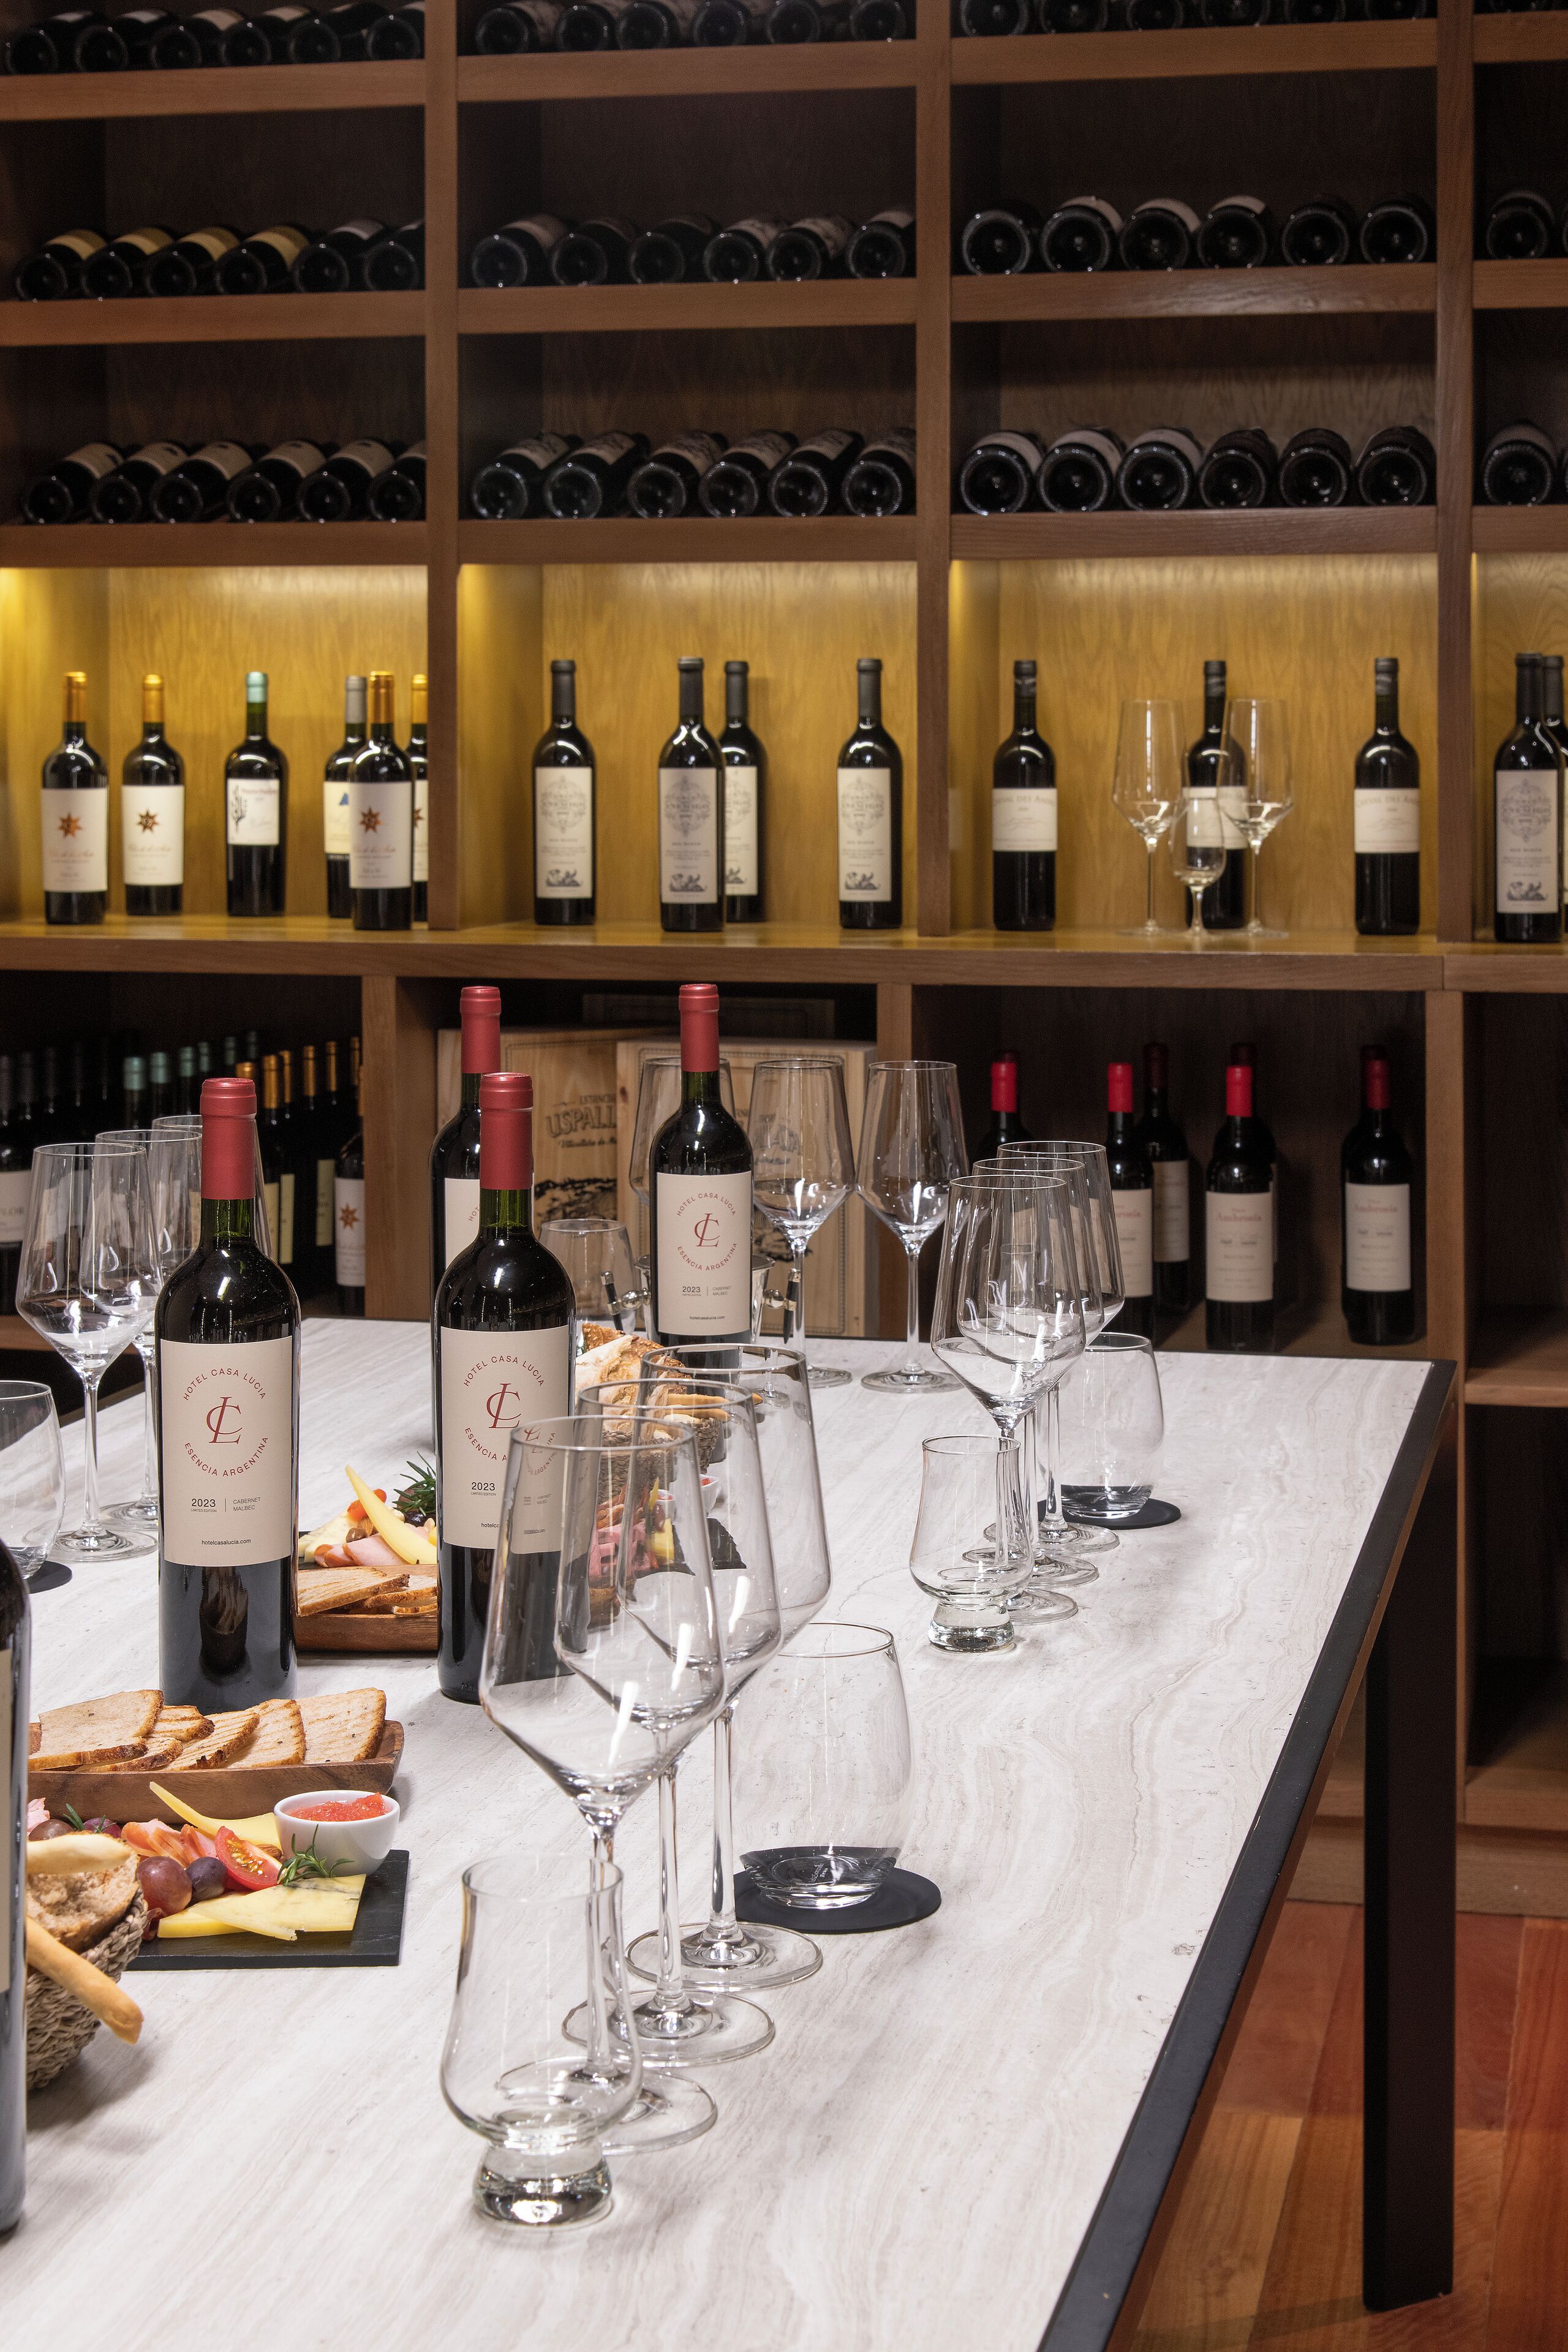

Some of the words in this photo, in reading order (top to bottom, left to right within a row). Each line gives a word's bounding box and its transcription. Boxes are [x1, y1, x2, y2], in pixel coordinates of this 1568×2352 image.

[545, 1106, 617, 1139] USPALL
[469, 1206, 480, 1221] HOT
[677, 1196, 696, 1216] HOTEL
[720, 1196, 736, 1216] LUCIA
[677, 1246, 703, 1270] ESENCIA
[706, 1243, 737, 1271] ARGENTINA
[183, 1373, 208, 1401] HOTEL
[211, 1368, 239, 1378] CASA
[243, 1373, 266, 1400] LUCIA
[464, 1360, 488, 1387] HOTEL
[491, 1355, 519, 1363] CASA
[522, 1360, 545, 1387] LUCIA
[184, 1442, 218, 1477] ESENCIA
[222, 1436, 269, 1477] ARGENTINA
[465, 1427, 497, 1461] ESENCIA
[471, 1482, 496, 1491] 2023
[191, 1498, 216, 1507] 2023
